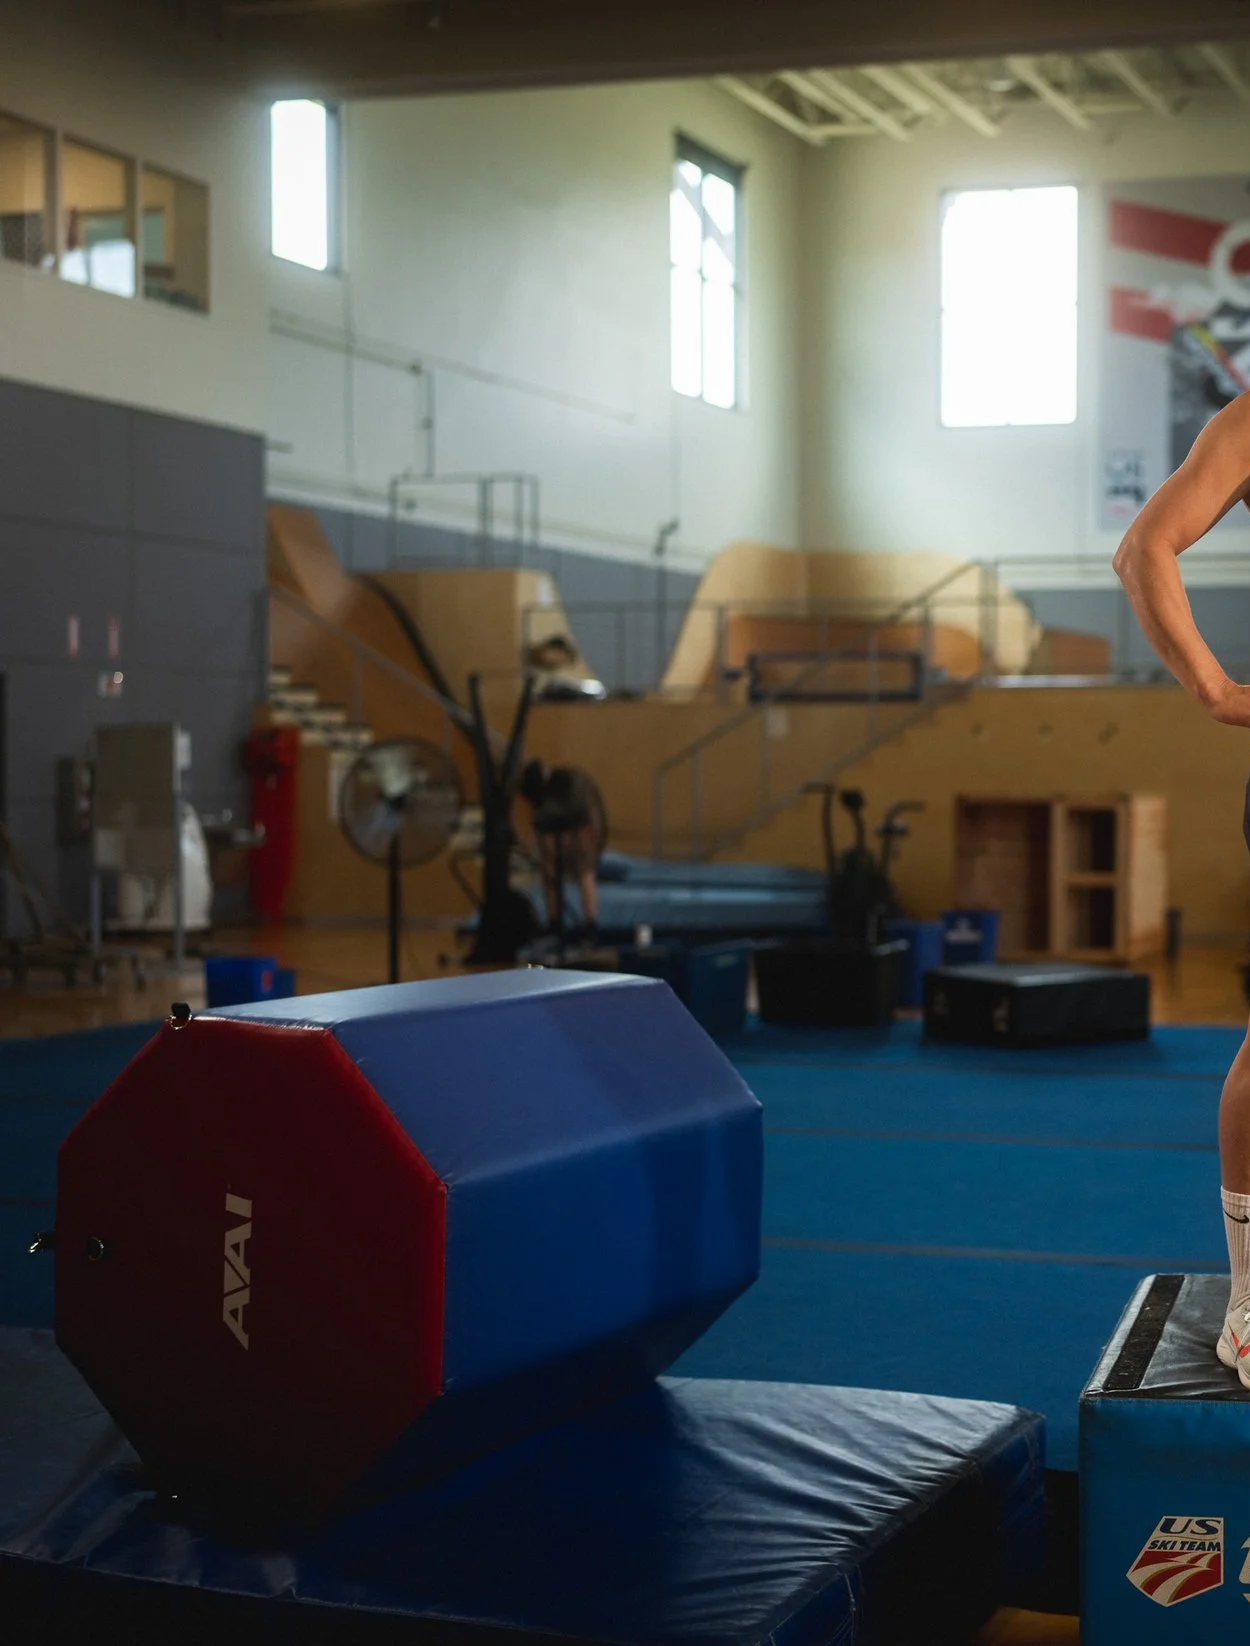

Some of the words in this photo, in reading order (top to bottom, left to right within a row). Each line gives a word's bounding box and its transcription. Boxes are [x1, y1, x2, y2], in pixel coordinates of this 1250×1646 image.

[1159, 1518, 1222, 1535] US
[1148, 1540, 1177, 1550] SKI
[1179, 1541, 1221, 1552] TEAM
